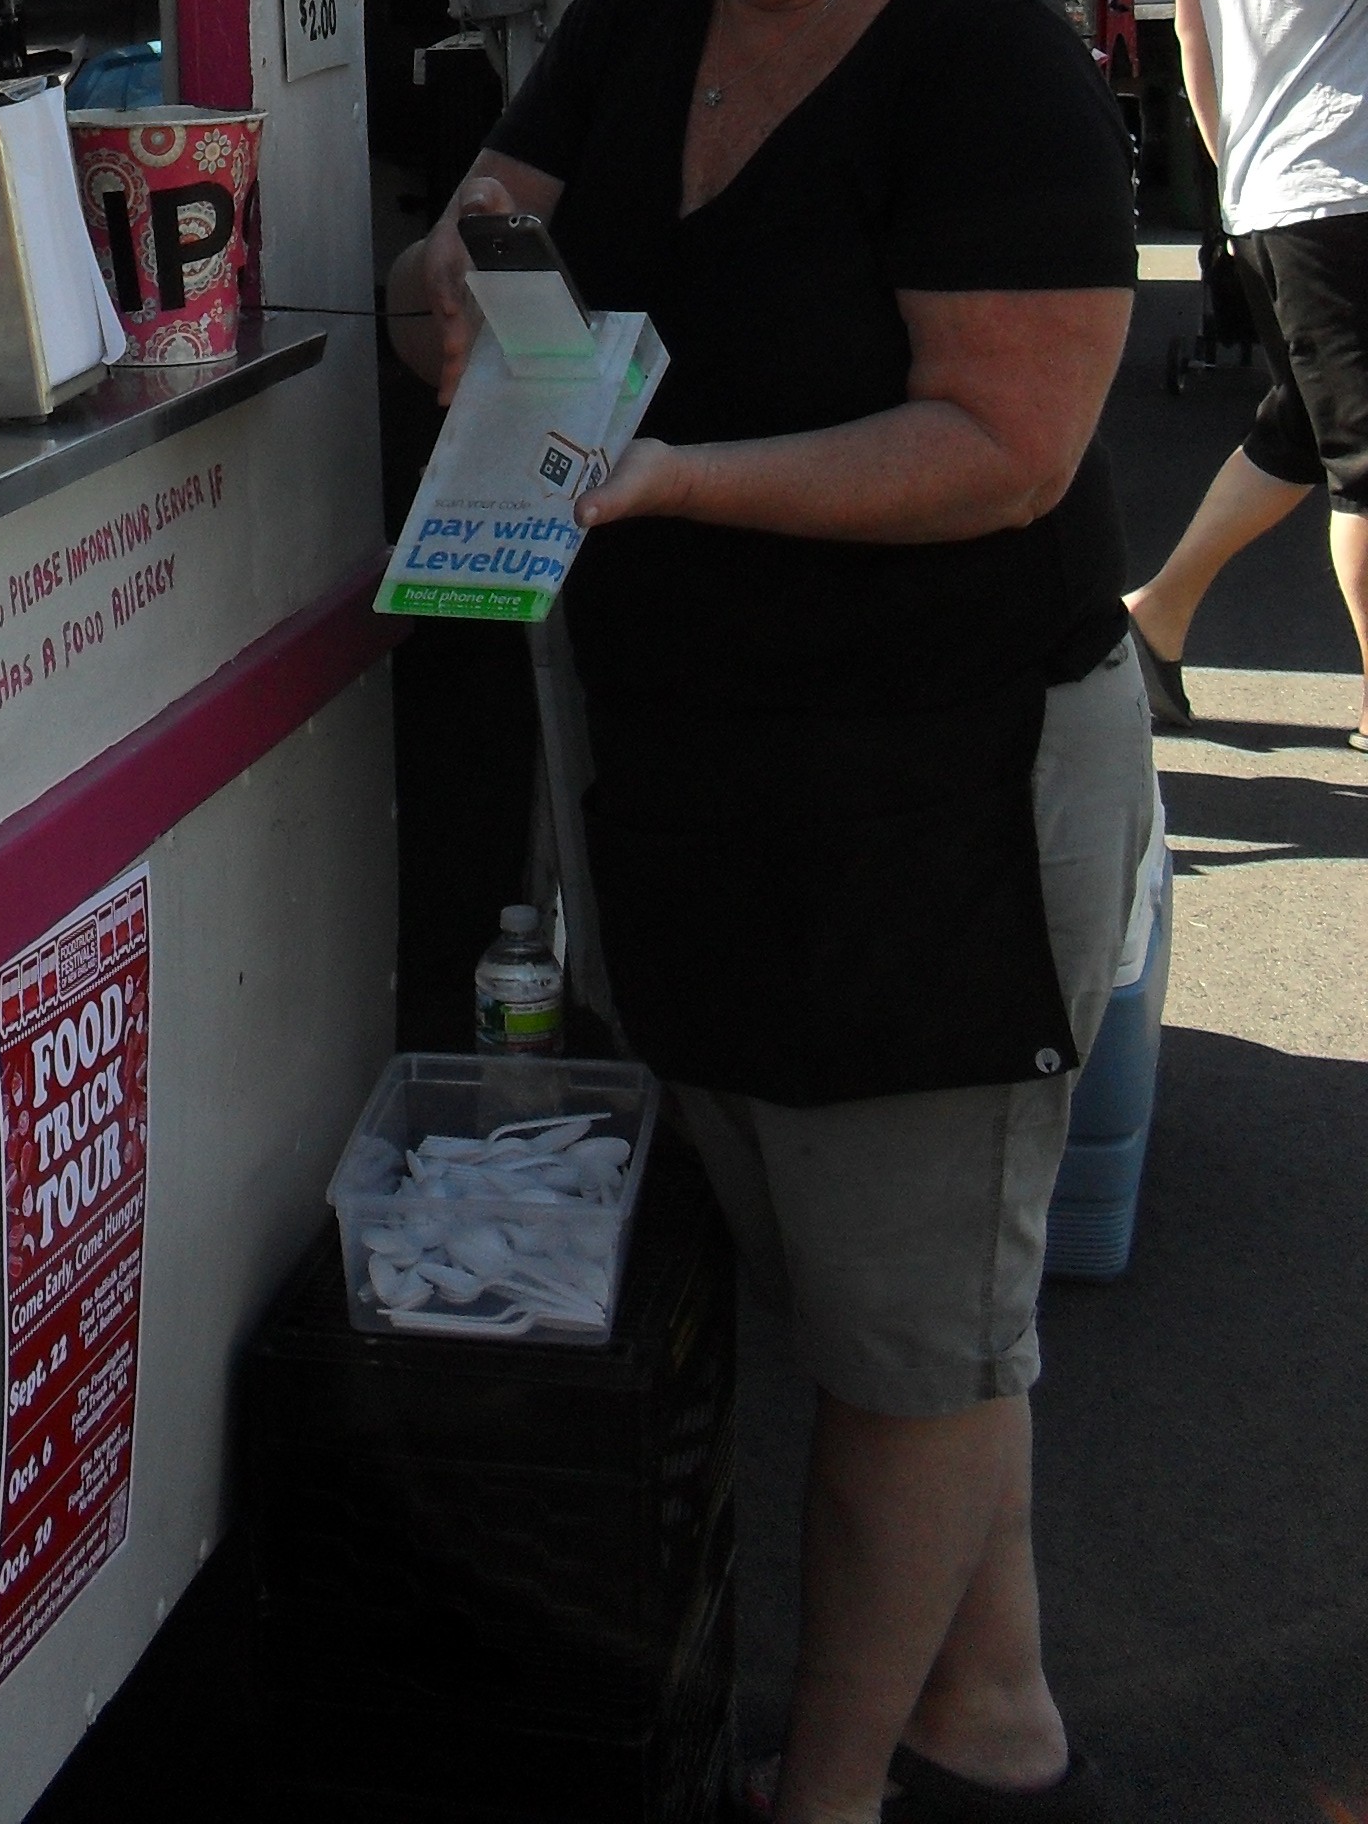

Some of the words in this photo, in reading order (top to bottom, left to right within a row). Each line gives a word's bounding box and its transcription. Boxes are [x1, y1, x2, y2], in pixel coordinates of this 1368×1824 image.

[8, 551, 63, 618] PLEASE
[65, 521, 114, 586] INFORM
[114, 503, 152, 554] YOUR
[154, 475, 205, 532] SERVER
[208, 464, 224, 509] IF
[405, 545, 551, 581] LevelUp
[419, 517, 484, 544] pay
[494, 517, 570, 544] with
[405, 588, 438, 600] hold
[439, 590, 484, 604] phone
[488, 592, 521, 605] here
[41, 636, 57, 679] A
[62, 610, 105, 668] FOOD
[31, 983, 123, 1109] FOOD
[34, 1056, 124, 1173] TRUCK
[36, 1121, 122, 1249] TOUR
[12, 1289, 44, 1335] Come
[45, 1257, 74, 1304] Early,
[75, 1229, 104, 1271] Come
[104, 1182, 143, 1243] Hungry!
[9, 1358, 47, 1417] Sept.
[50, 1333, 68, 1375] 22
[8, 1454, 39, 1505] Oct.
[42, 1435, 53, 1467] 6
[0, 1543, 30, 1595] Oct.
[33, 1516, 52, 1556] 20
